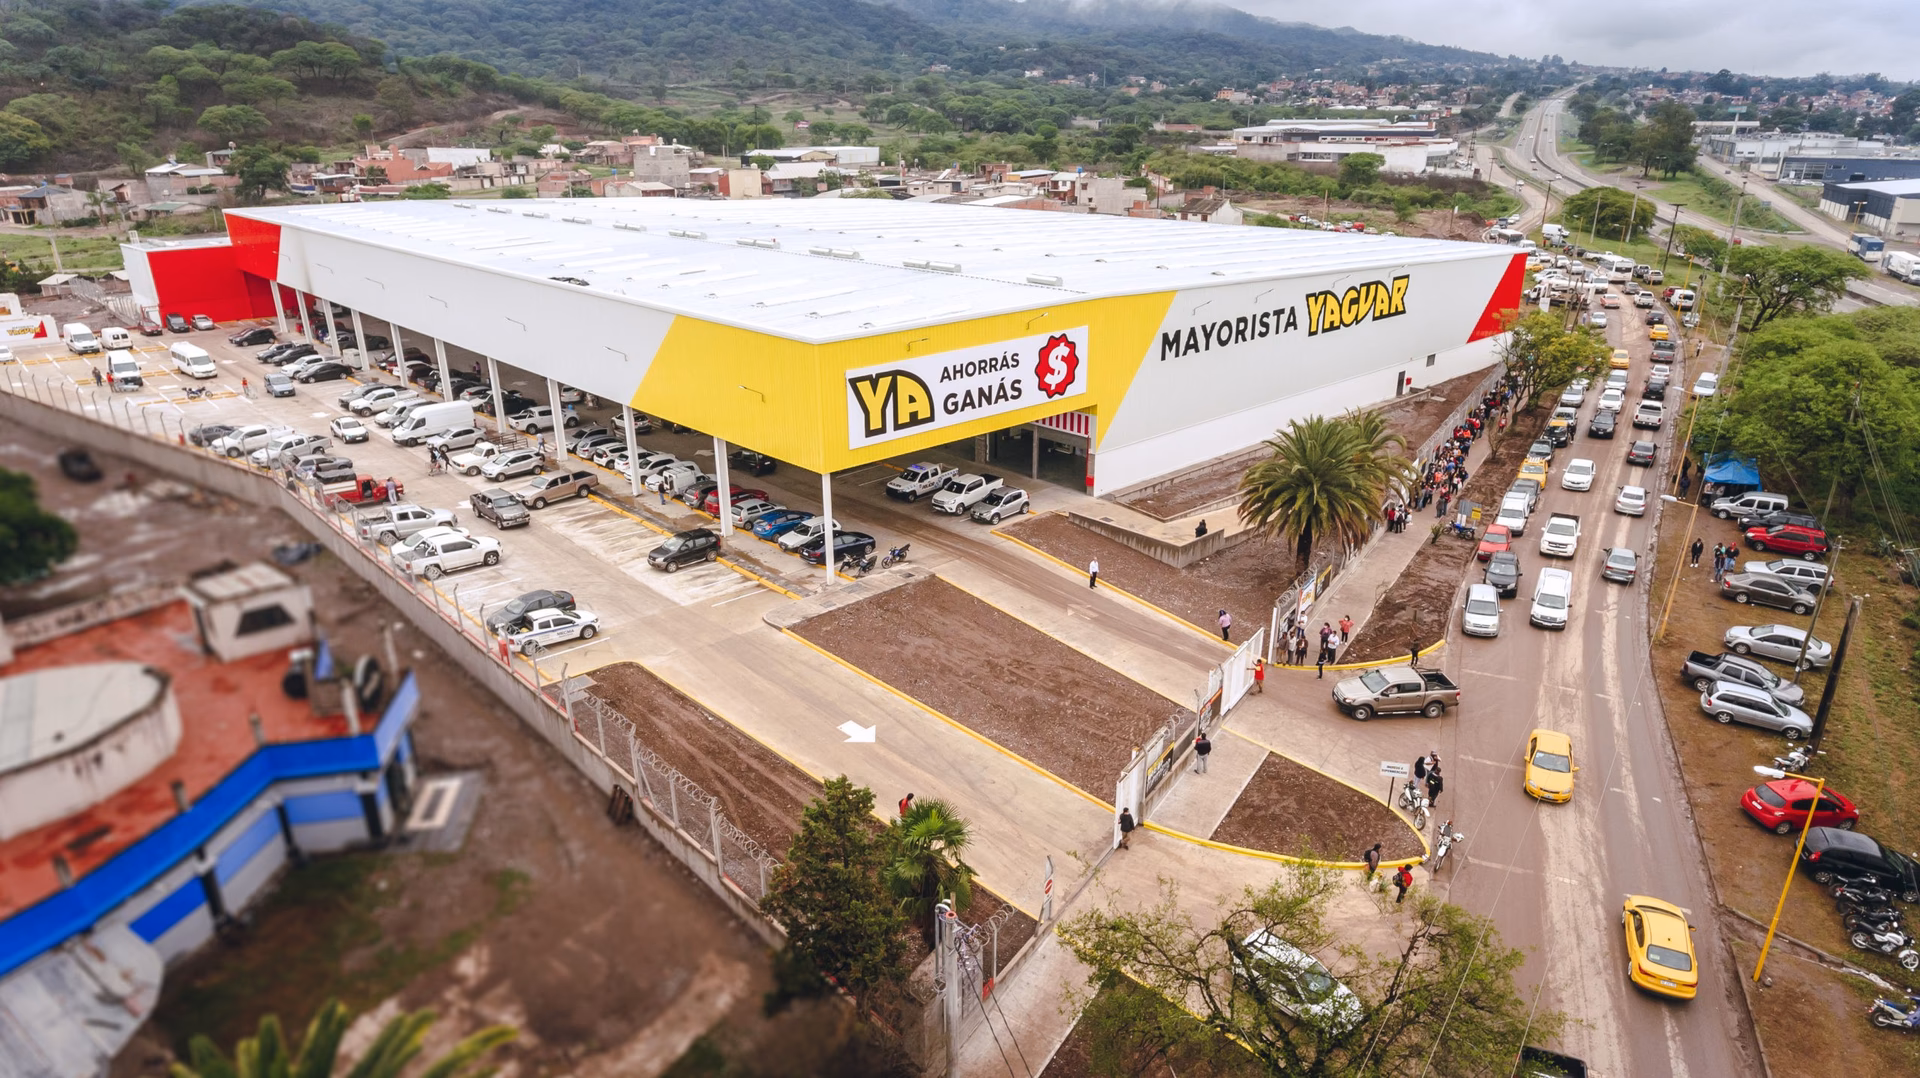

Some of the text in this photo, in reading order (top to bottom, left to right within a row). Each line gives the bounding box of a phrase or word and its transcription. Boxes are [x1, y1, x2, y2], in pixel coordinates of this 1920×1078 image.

[1160, 306, 1298, 361] MAYORISTA
[939, 351, 1020, 383] AHORRÁS
[848, 369, 935, 438] YA
[943, 377, 1022, 415] GANÁS
